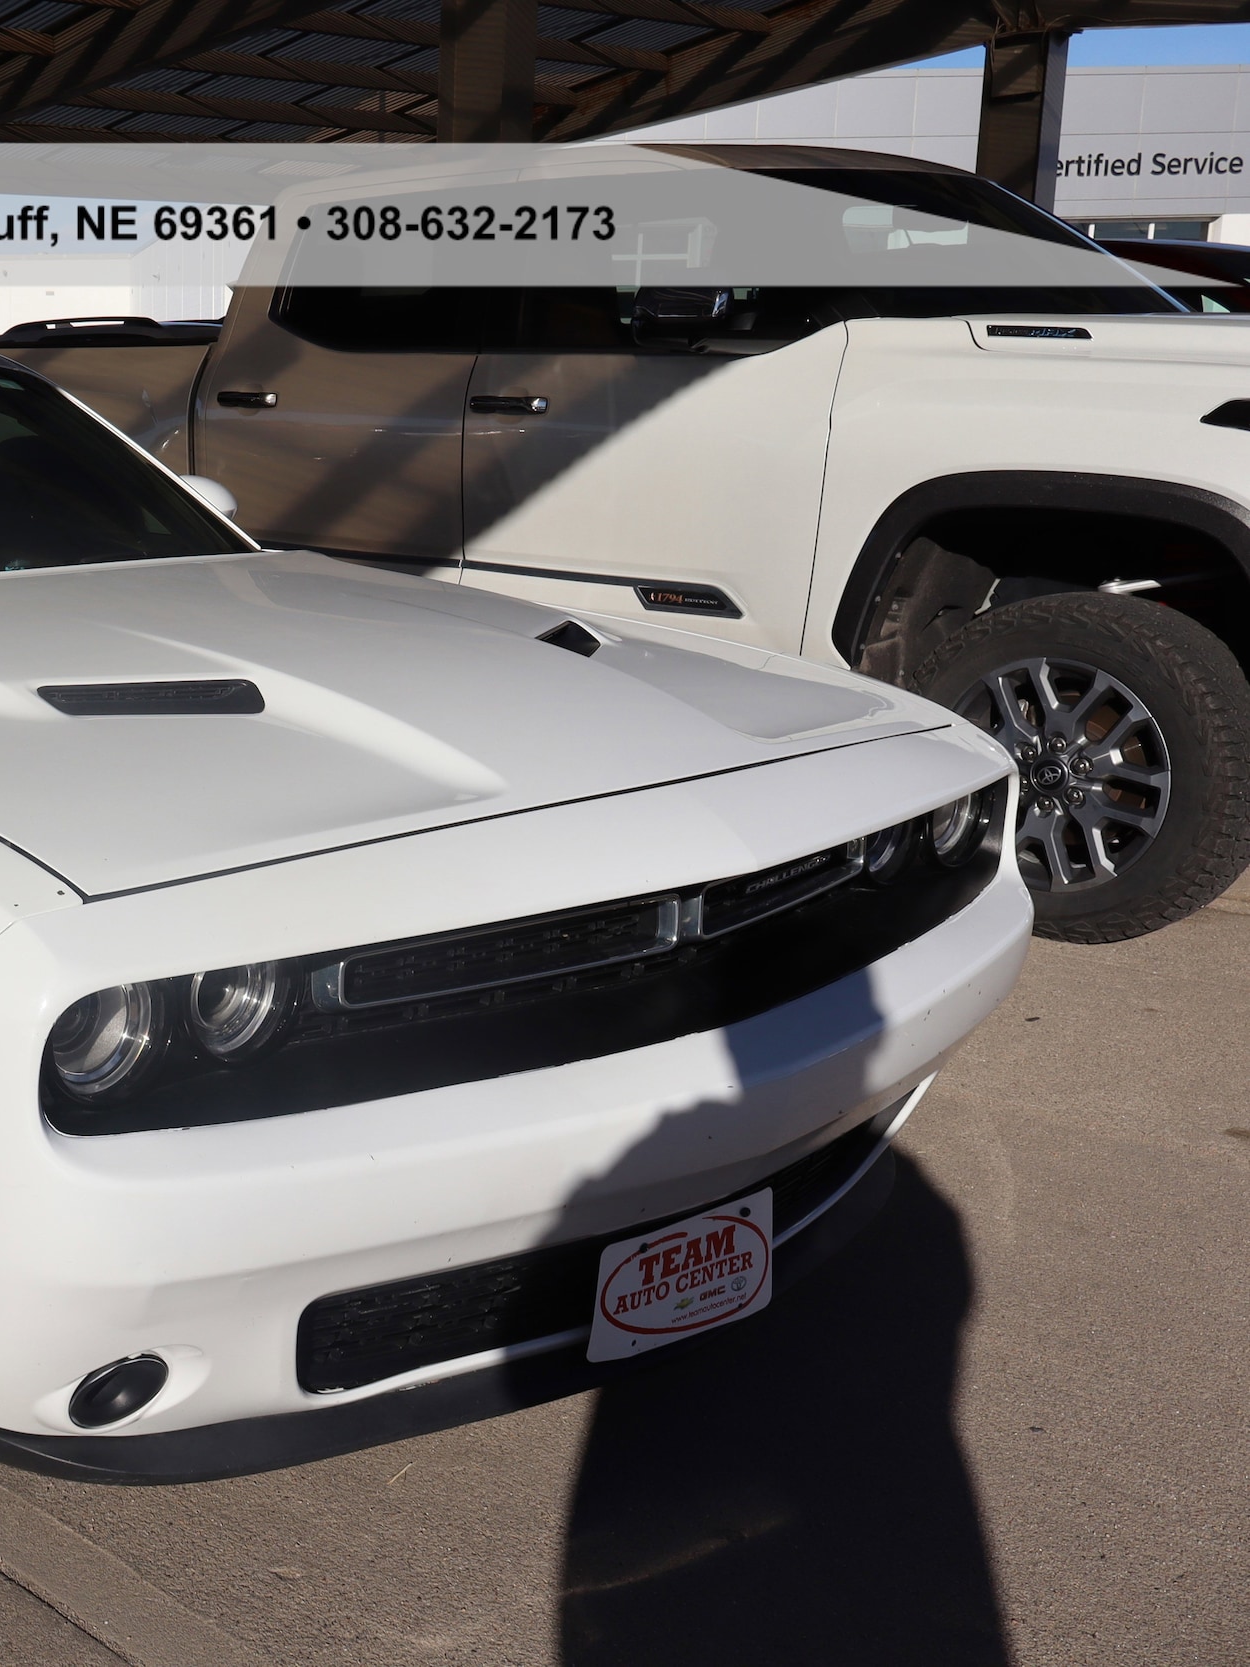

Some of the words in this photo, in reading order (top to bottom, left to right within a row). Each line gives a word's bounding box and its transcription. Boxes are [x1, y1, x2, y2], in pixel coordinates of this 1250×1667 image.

[1151, 152, 1244, 176] Service
[657, 593, 684, 604] 1794
[638, 1224, 737, 1287] TEAM
[613, 1281, 671, 1316] AUTO
[675, 1251, 754, 1294] CENTER
[699, 1285, 727, 1301] GMC
[671, 1292, 748, 1324] www.teamautocenter.net
